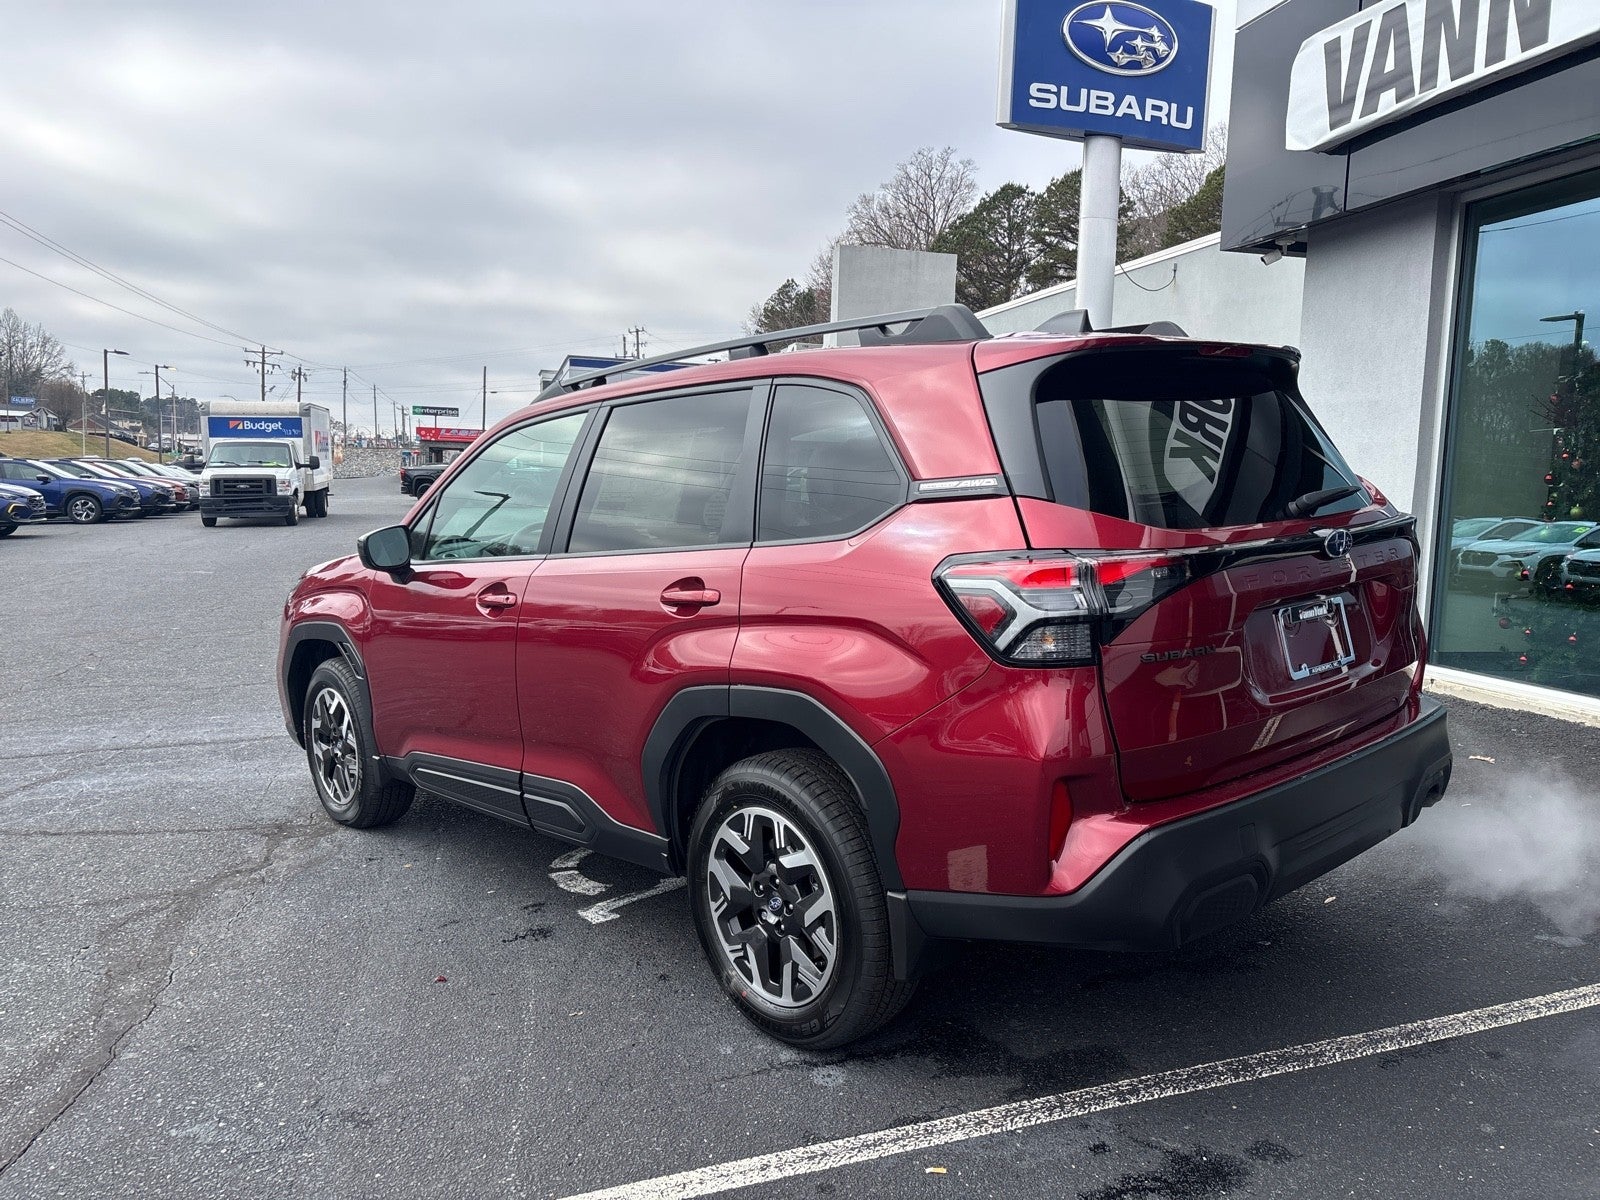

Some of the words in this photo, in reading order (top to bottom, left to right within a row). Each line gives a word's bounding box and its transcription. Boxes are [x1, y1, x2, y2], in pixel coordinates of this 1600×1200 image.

[1324, 0, 1550, 132] VANN
[1029, 82, 1194, 130] SUBARU
[244, 420, 283, 433] Budget
[414, 407, 458, 415] enterprise
[1243, 546, 1401, 589] FORESTER
[1140, 644, 1217, 663] SUBARU
